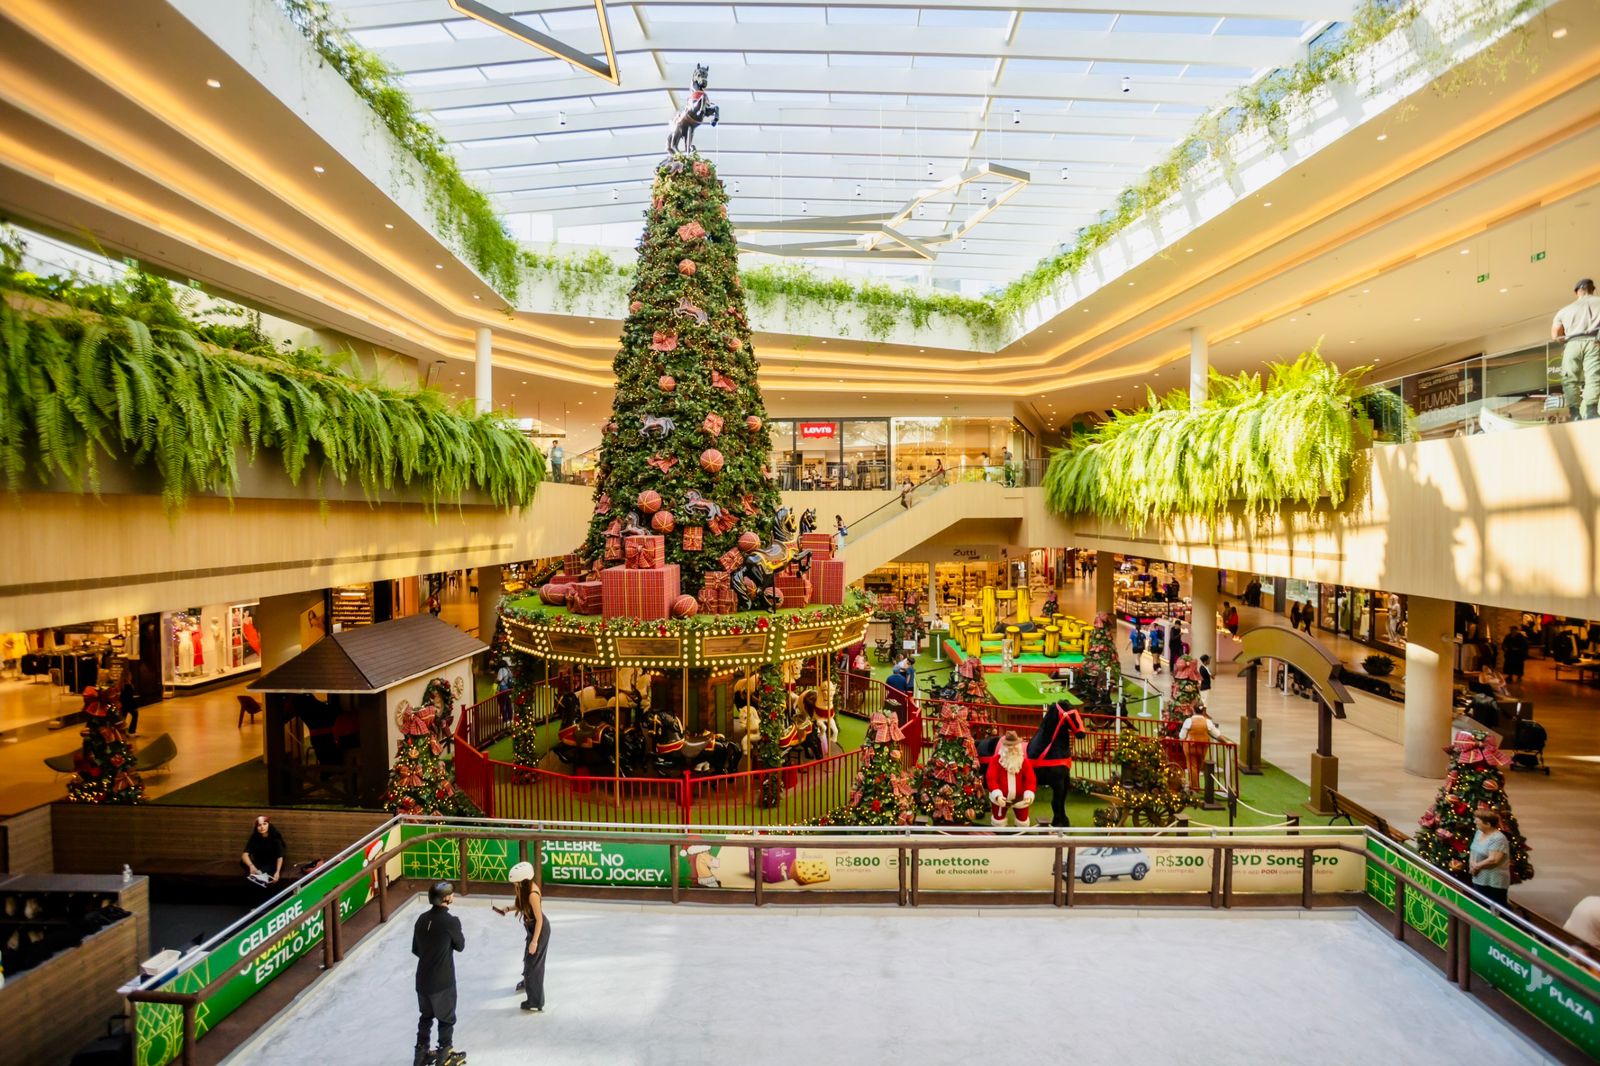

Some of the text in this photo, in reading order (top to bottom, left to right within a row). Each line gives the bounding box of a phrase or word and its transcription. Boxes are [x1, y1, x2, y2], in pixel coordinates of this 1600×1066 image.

[1419, 388, 1458, 410] HUMAN
[551, 853, 598, 866] NATAL
[600, 854, 624, 866] NO
[836, 856, 880, 867] R$800
[1156, 856, 1204, 867] R$300
[1267, 855, 1304, 868] Song
[1312, 855, 1338, 866] Pro
[552, 867, 668, 882] ESTILO JOCKEY.
[238, 899, 304, 957] CELEBRE
[255, 935, 304, 985] ESTILO
[1487, 945, 1594, 1025] JOCKEY PLAZA
